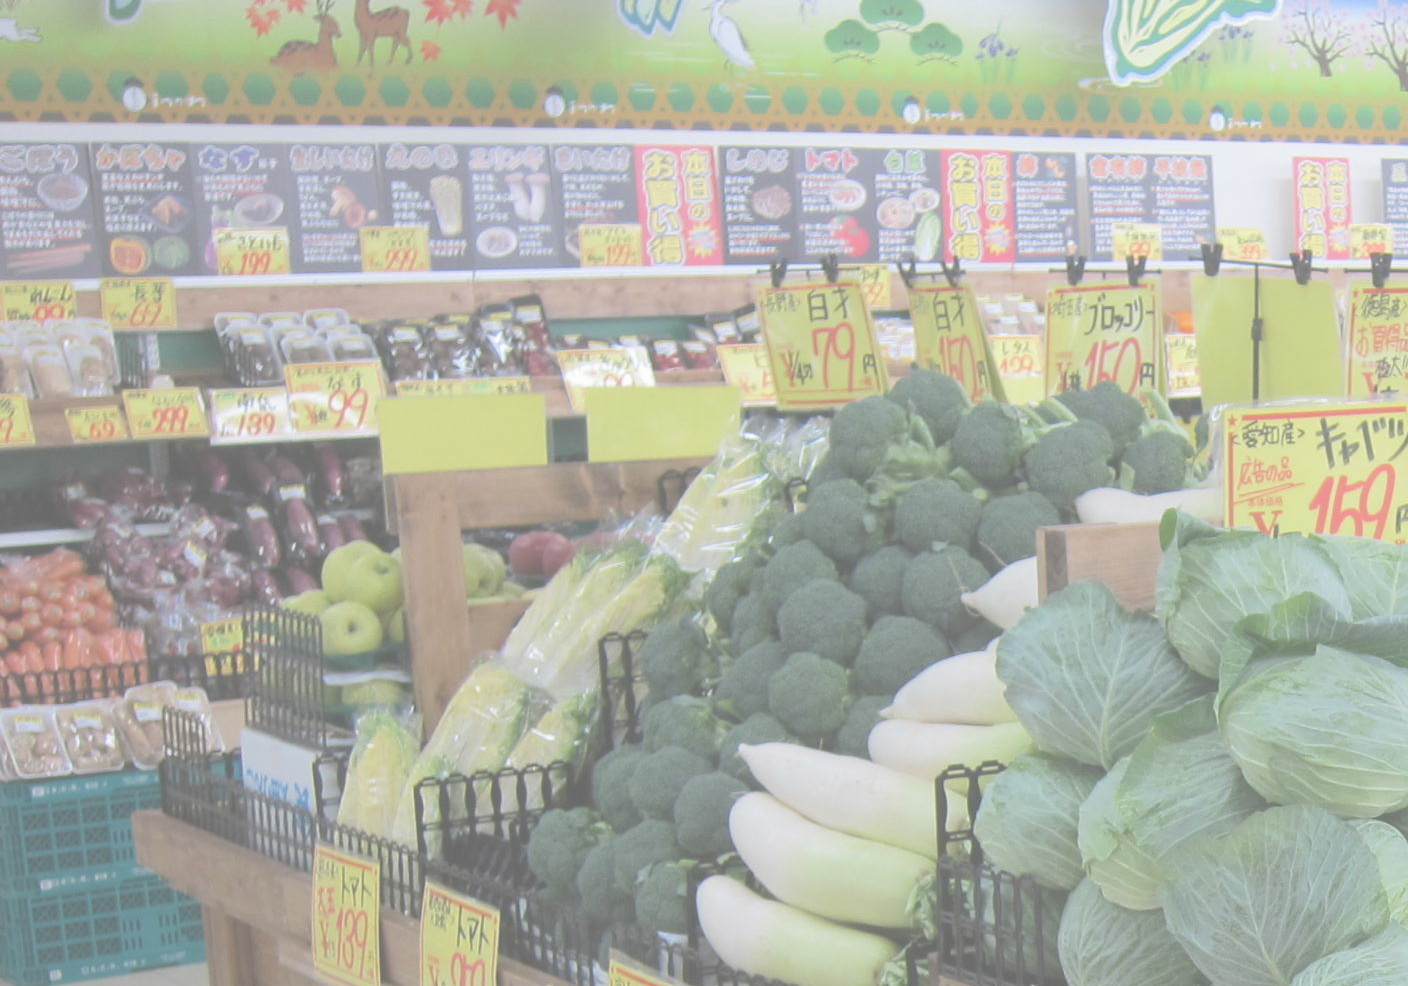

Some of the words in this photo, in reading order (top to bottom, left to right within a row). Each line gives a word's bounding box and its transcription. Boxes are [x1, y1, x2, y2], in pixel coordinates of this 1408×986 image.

[96, 143, 187, 172] かぼちゃ
[468, 145, 546, 173] エリンギ
[554, 145, 631, 173] まいたけ
[726, 148, 790, 173] しめじ
[803, 146, 861, 174] トマト
[641, 147, 686, 266] お買い得
[680, 148, 712, 222] 本日の
[948, 151, 983, 263] お買い得
[980, 151, 1008, 222] 本日の
[1325, 159, 1348, 222] 本日の
[1299, 159, 1327, 258] お買い得
[1084, 292, 1156, 336] ブロッコリー
[812, 320, 856, 392] 79
[1138, 362, 1156, 387] 円
[152, 405, 191, 434] 299
[328, 389, 370, 431] 99
[1308, 462, 1396, 540] 159
[341, 865, 373, 908] トマト
[456, 904, 489, 956] トマト
